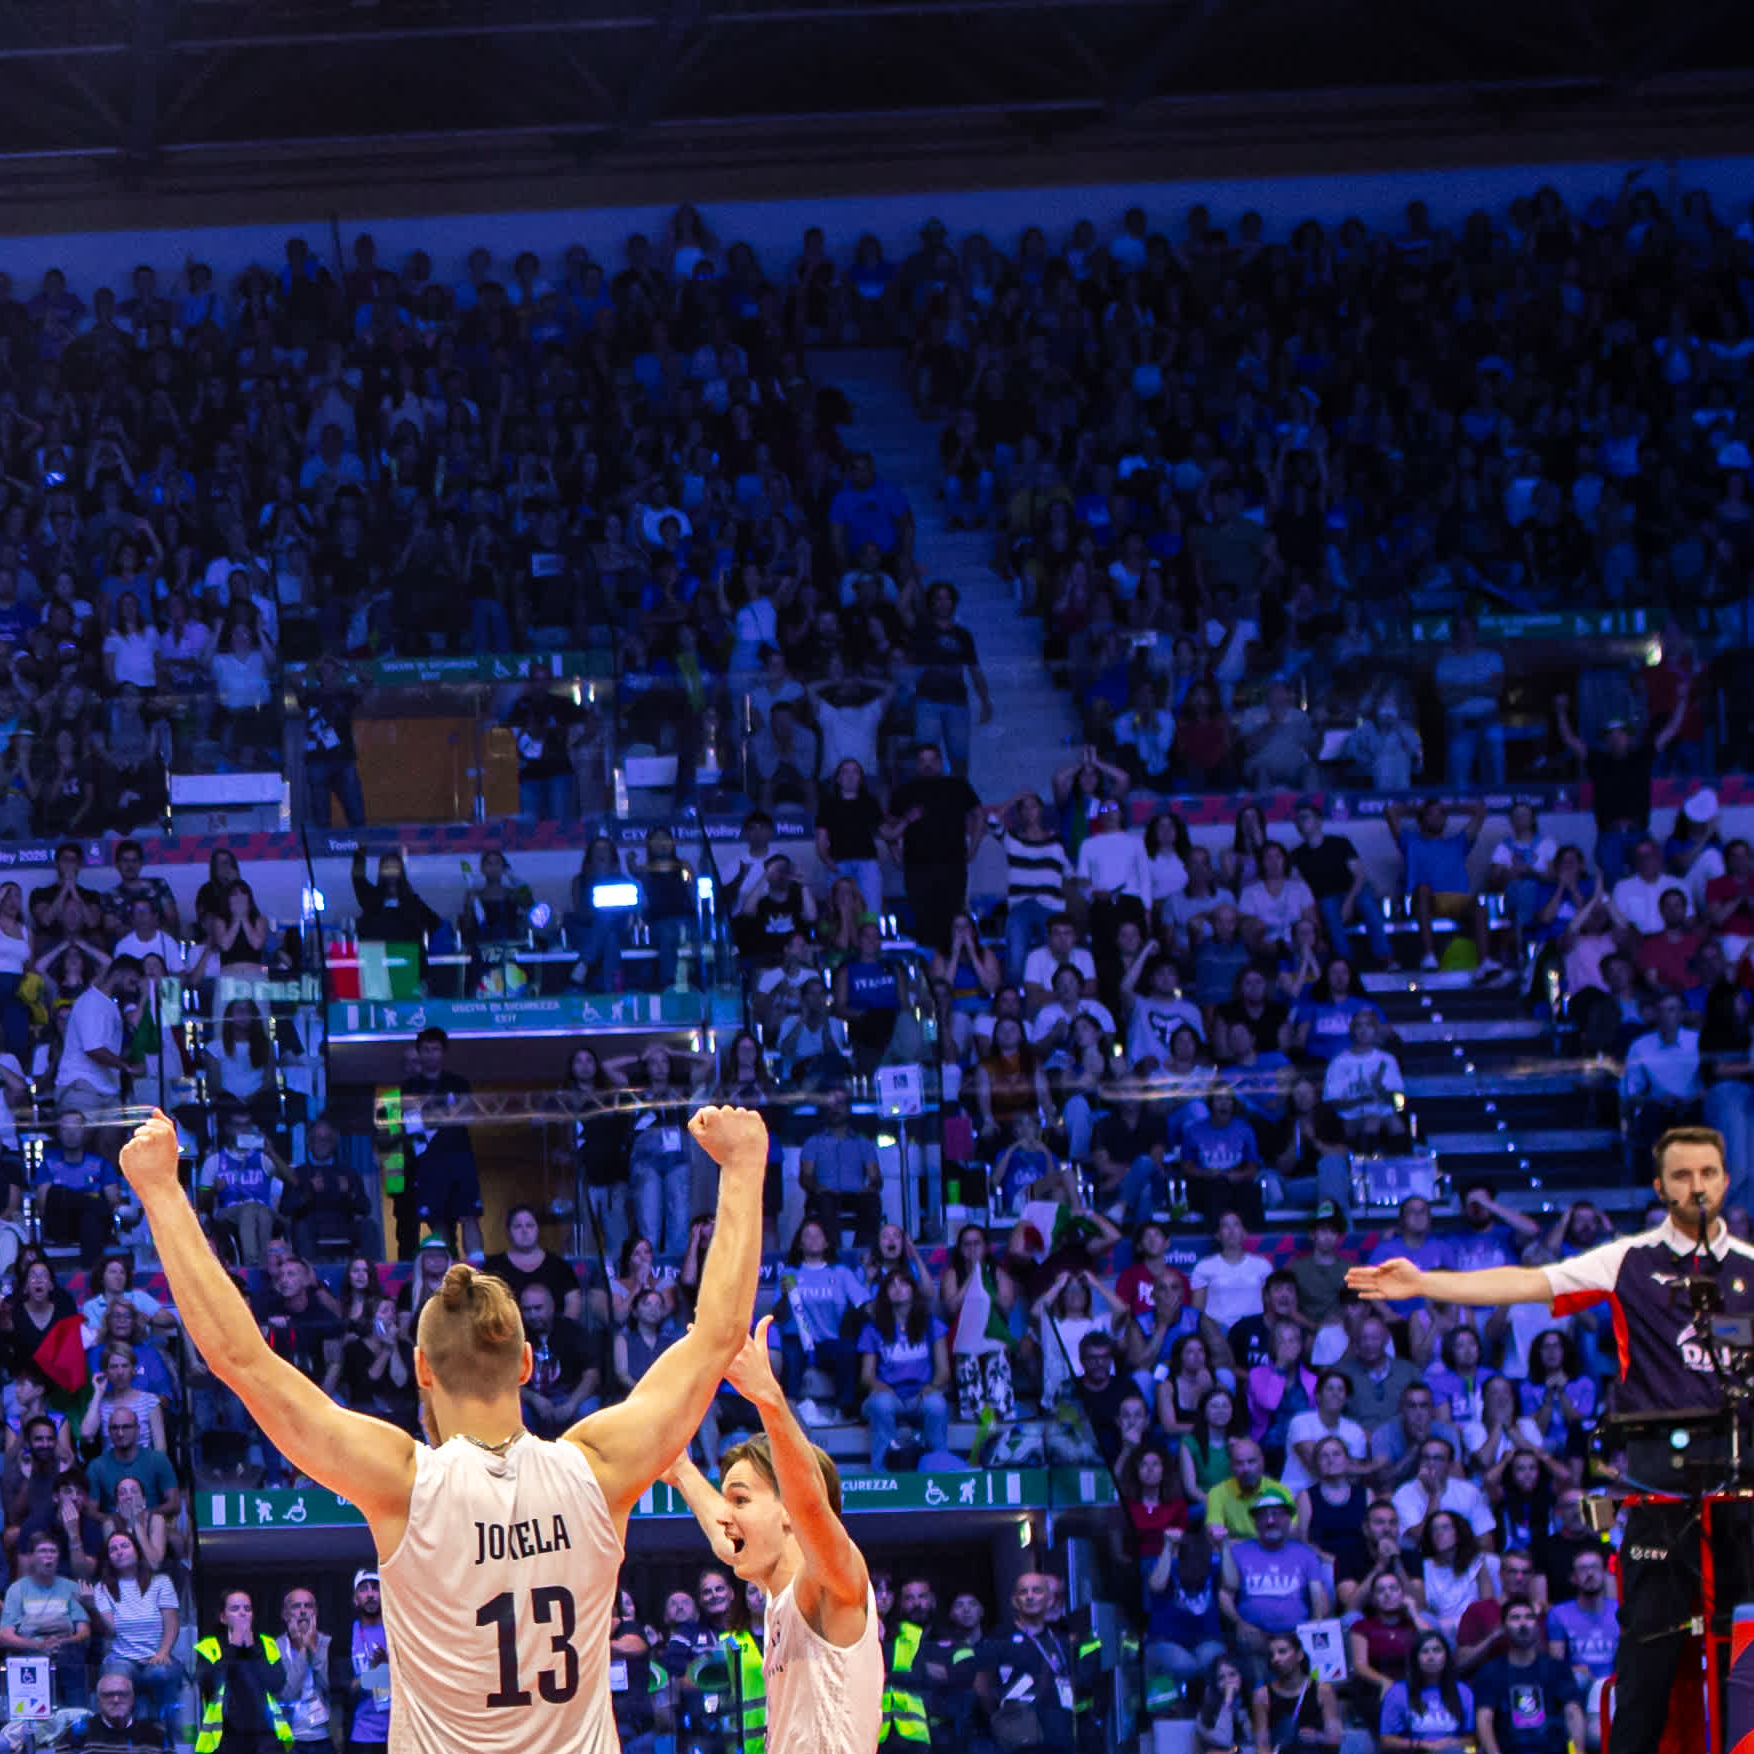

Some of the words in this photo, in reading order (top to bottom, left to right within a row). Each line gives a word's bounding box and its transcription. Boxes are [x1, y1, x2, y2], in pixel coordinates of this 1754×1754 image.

[328, 838, 359, 851] Torin
[841, 1479, 899, 1491] CUREZZA
[475, 1585, 580, 1709] 13
